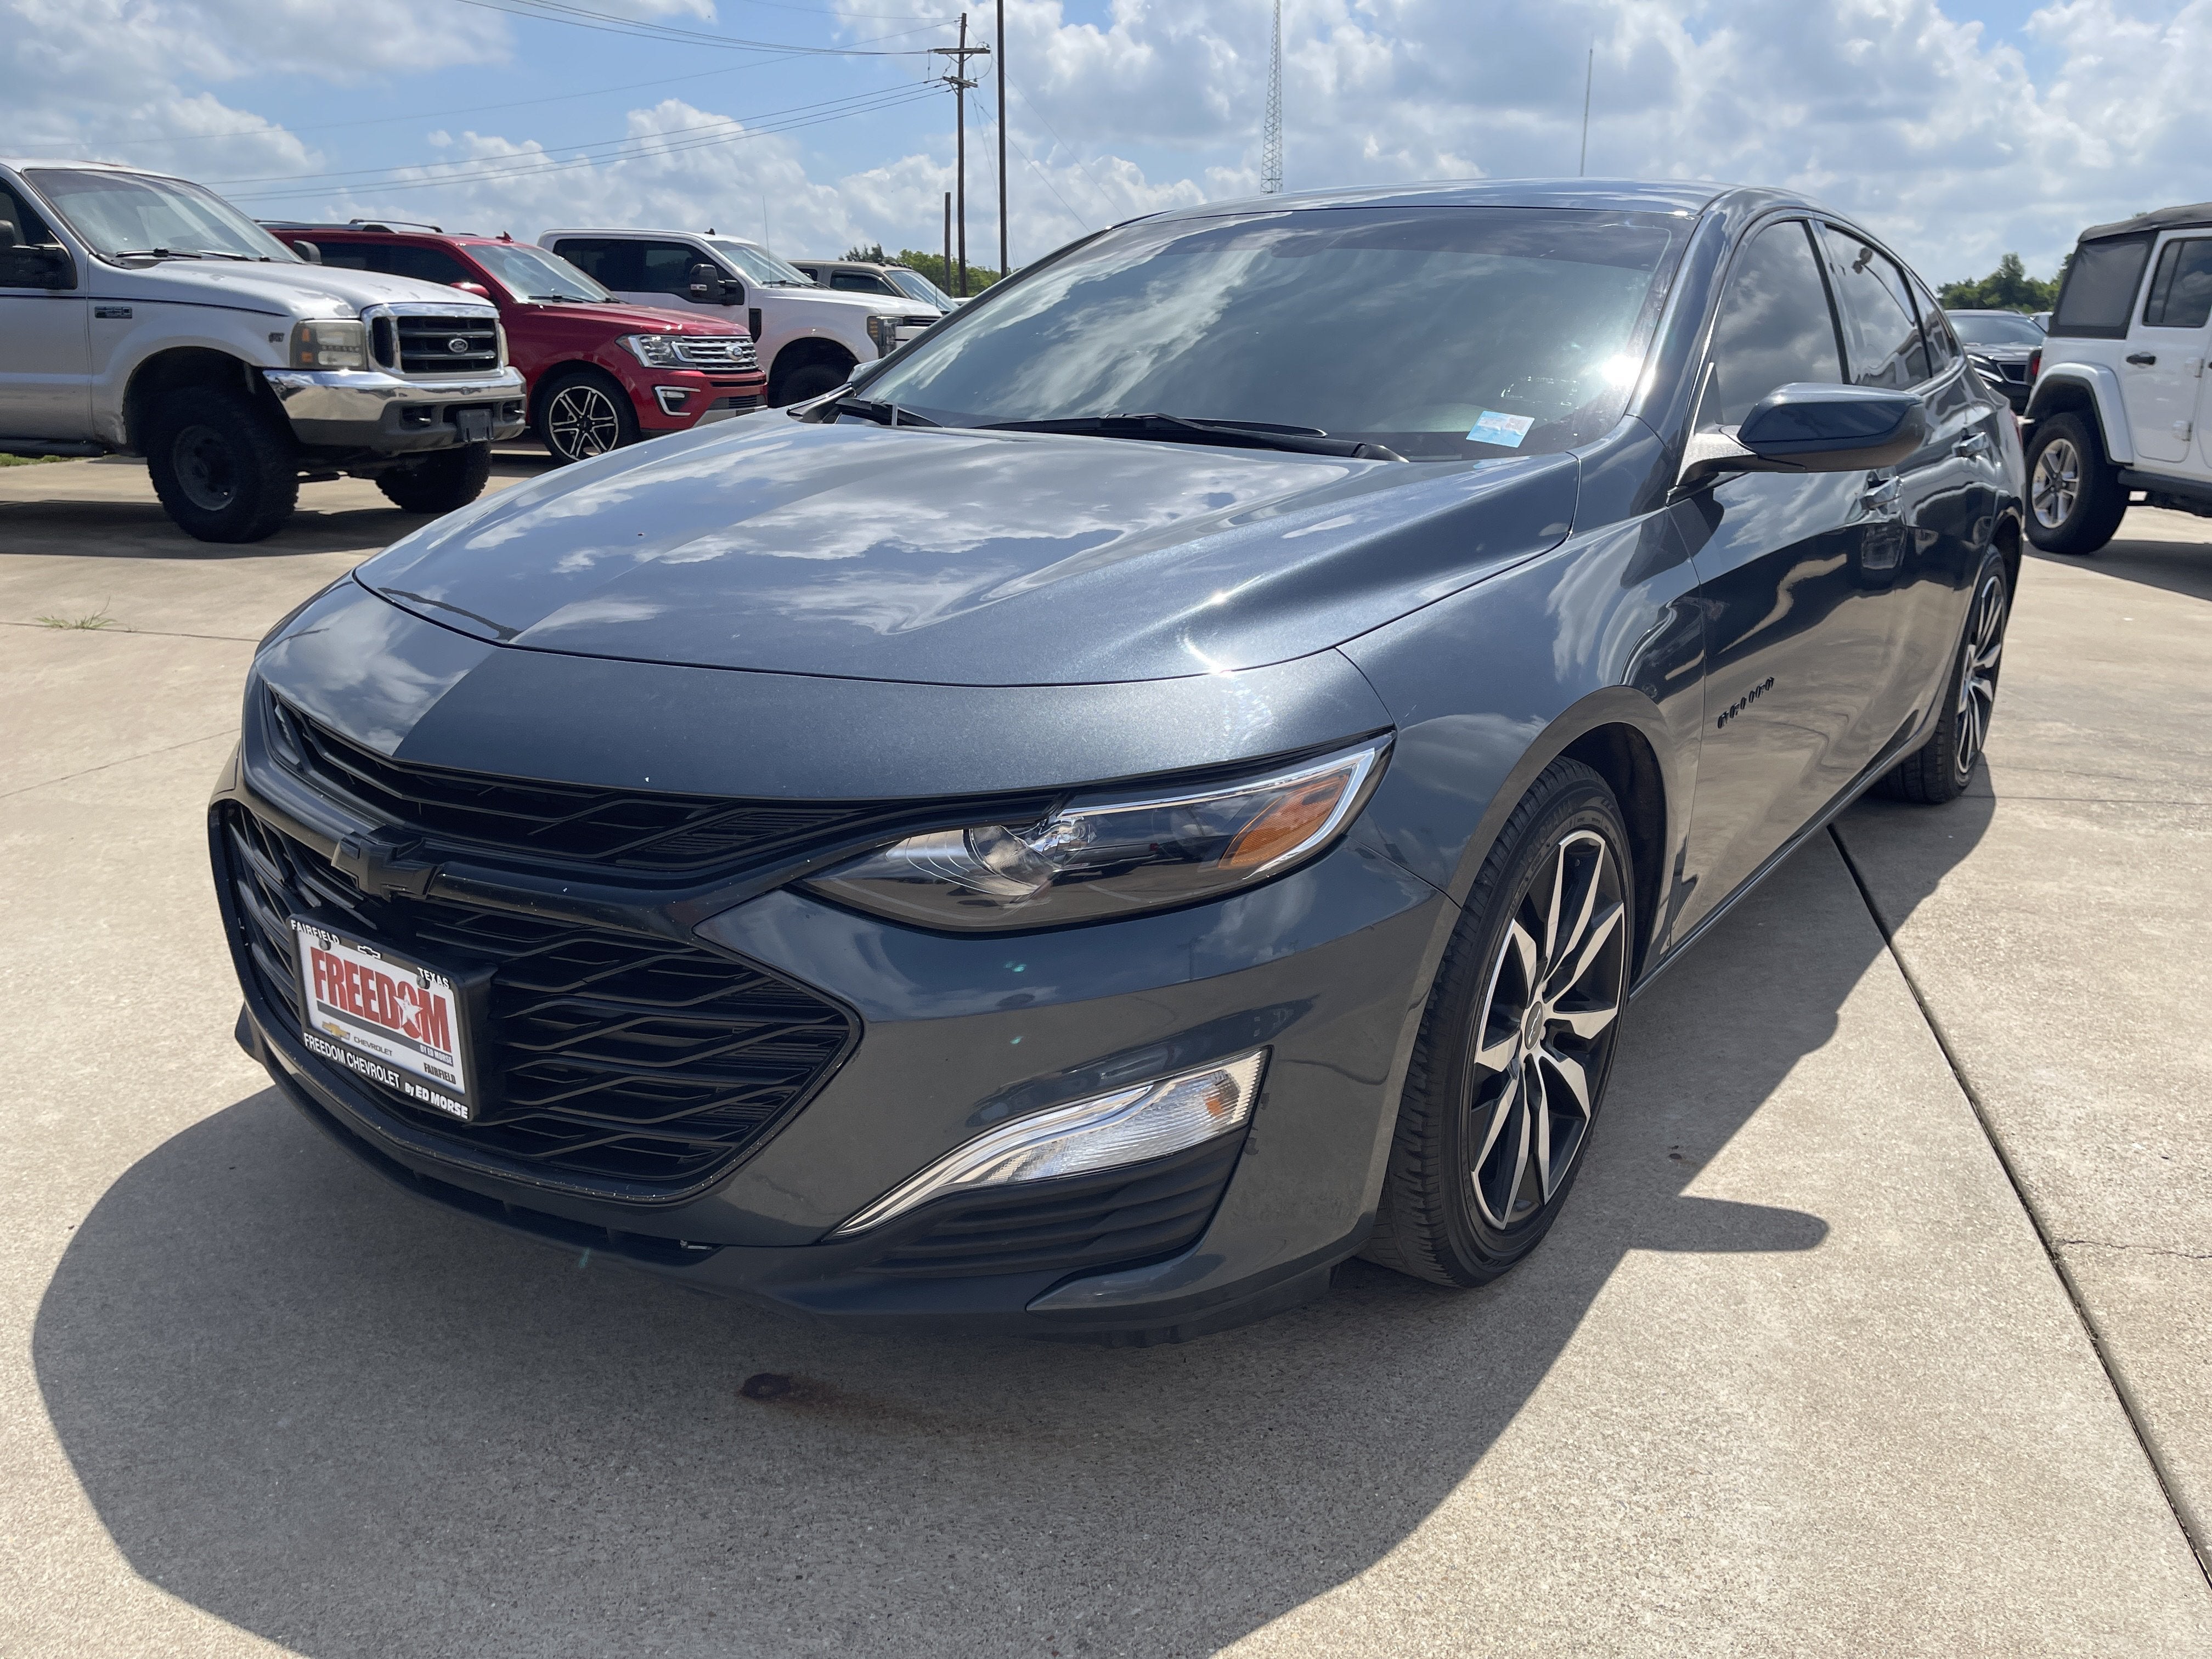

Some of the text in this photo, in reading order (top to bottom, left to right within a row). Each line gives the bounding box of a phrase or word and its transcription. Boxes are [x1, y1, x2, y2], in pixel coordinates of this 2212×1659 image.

[291, 919, 340, 945] FAIRFIELD
[417, 967, 450, 989] TEXAS
[310, 947, 452, 1053] FREEDOM
[354, 1036, 393, 1057] CHEVROLET
[420, 1045, 452, 1064] BY ED MORSE
[303, 1032, 347, 1064] FREEDOM
[347, 1052, 400, 1089] CHEVROLET
[415, 1085, 430, 1101] ED
[431, 1092, 468, 1119] MORSE
[424, 1063, 456, 1084] FAIRFIELD
